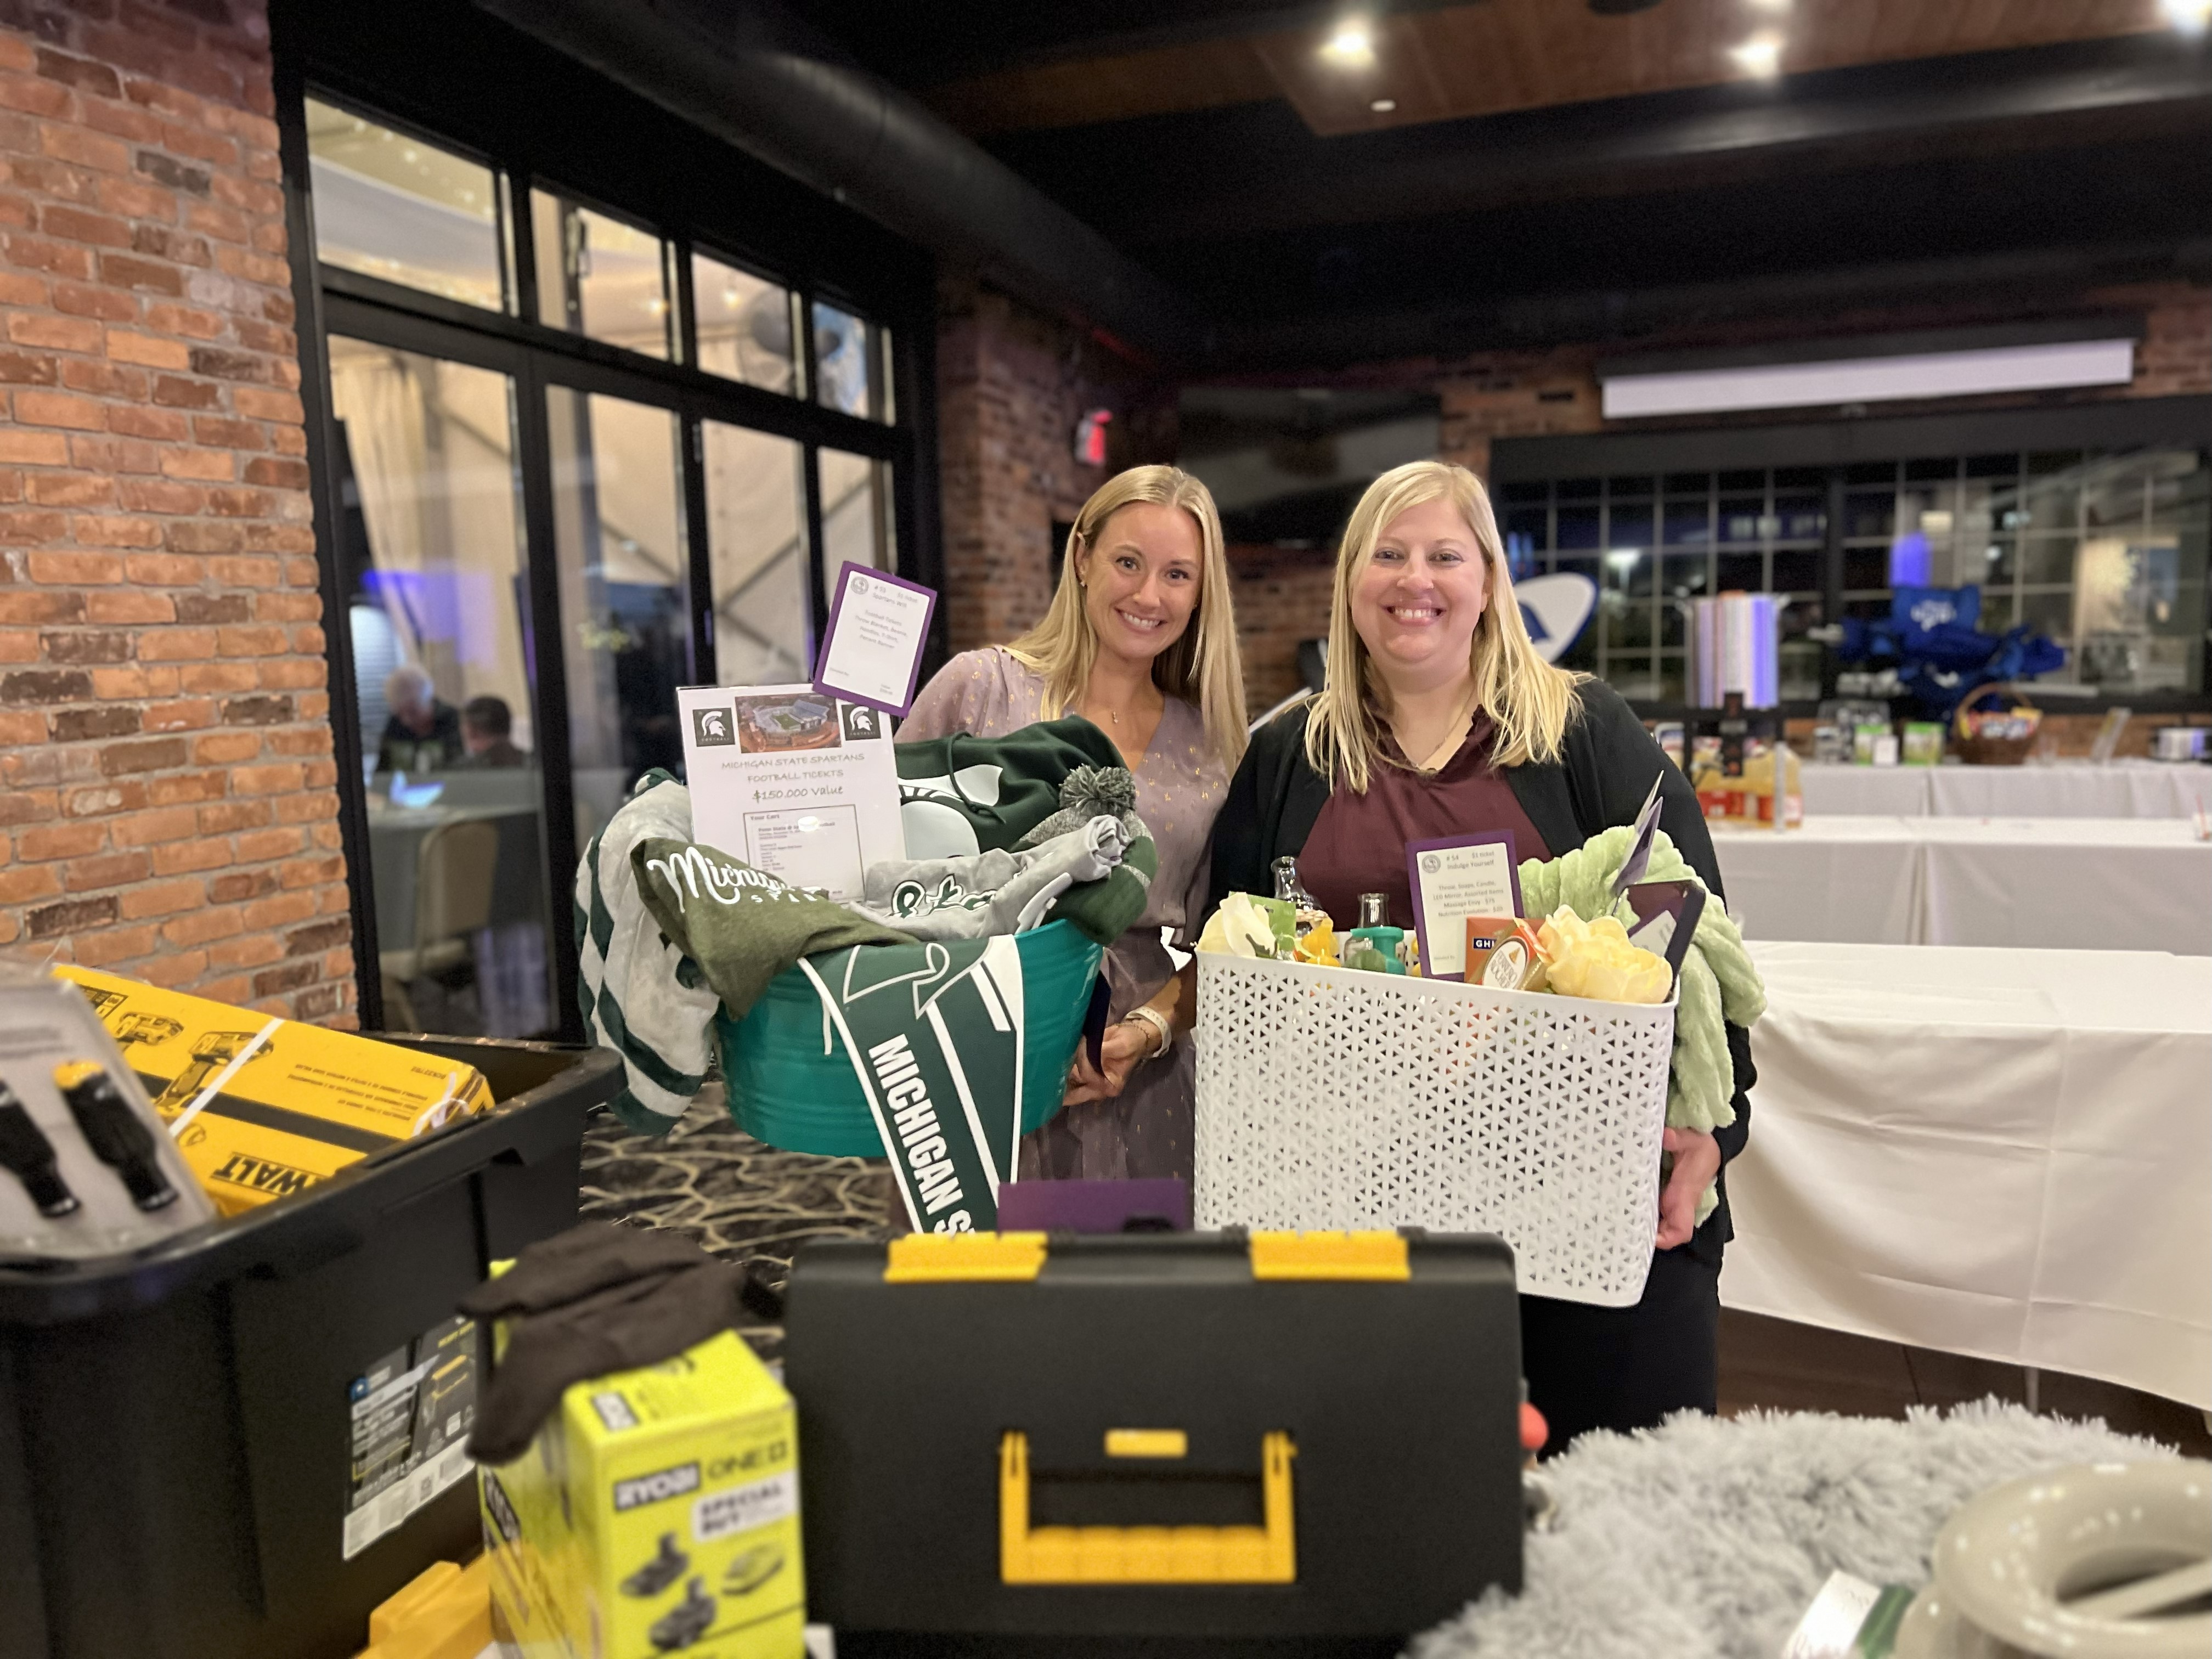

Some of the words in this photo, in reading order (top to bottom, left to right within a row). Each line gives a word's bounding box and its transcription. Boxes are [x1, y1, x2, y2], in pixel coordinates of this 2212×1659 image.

[721, 759, 772, 769] MICHIGAN
[775, 757, 807, 766] STATE
[810, 753, 865, 764] SPARTANS
[748, 772, 799, 783] FOOTBALL
[802, 769, 844, 778] TICEKTS
[1470, 859, 1494, 867] Yourself
[868, 1034, 963, 1215] MICHIGAN
[616, 1463, 699, 1511] RYOBI
[701, 1483, 781, 1517] SPECIAL
